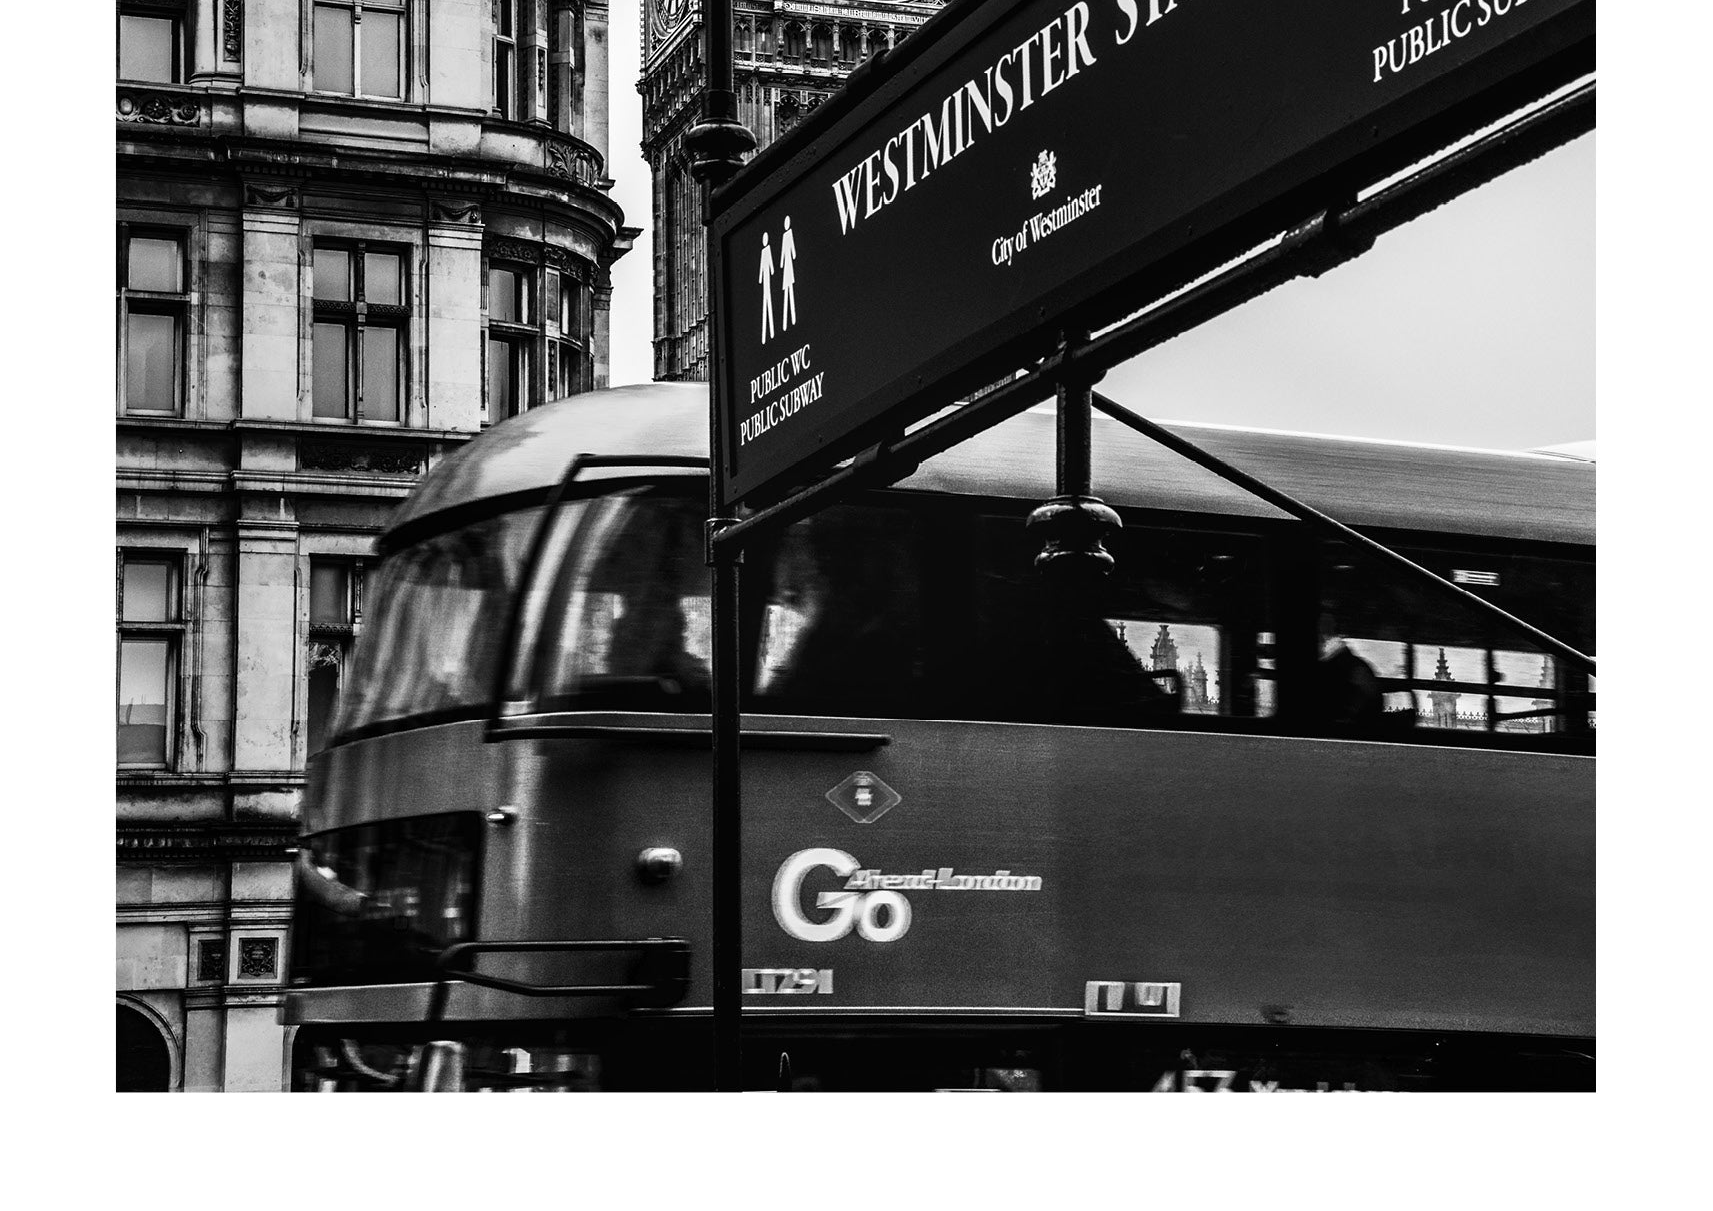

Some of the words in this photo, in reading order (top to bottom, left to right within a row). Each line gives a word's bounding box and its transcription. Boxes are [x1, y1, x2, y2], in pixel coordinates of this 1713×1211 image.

[831, 0, 1097, 236] WESTMINSTER
[991, 236, 1015, 266] City
[1015, 220, 1029, 252] of
[1029, 183, 1102, 243] Westminster
[740, 401, 779, 446] PUBLIC
[779, 371, 824, 422] SUBWAY
[750, 357, 790, 404] PUBLIC
[790, 343, 811, 376] WC
[771, 847, 913, 942] Go
